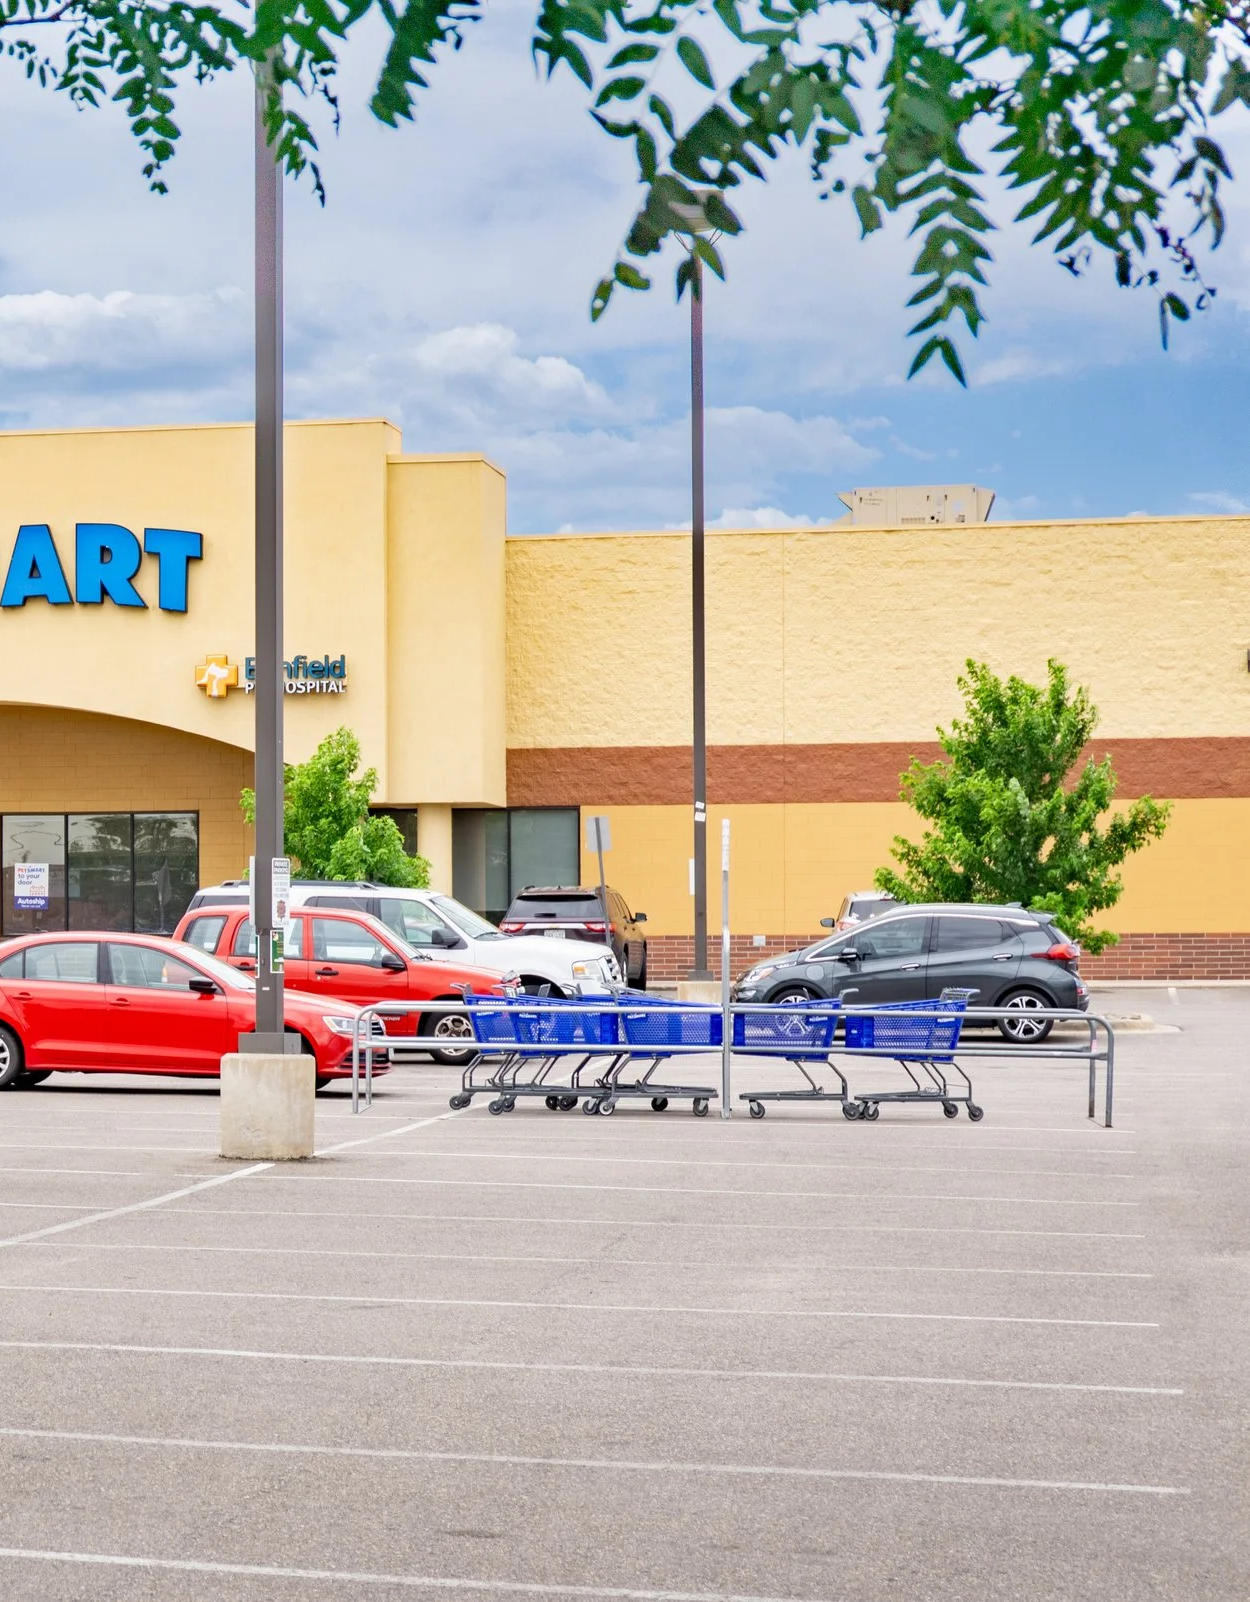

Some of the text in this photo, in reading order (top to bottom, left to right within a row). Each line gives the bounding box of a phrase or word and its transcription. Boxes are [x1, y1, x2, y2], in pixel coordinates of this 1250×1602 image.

[244, 654, 346, 680] Bnfield
[283, 680, 346, 695] OSPITAL
[17, 897, 46, 906] Autoship
